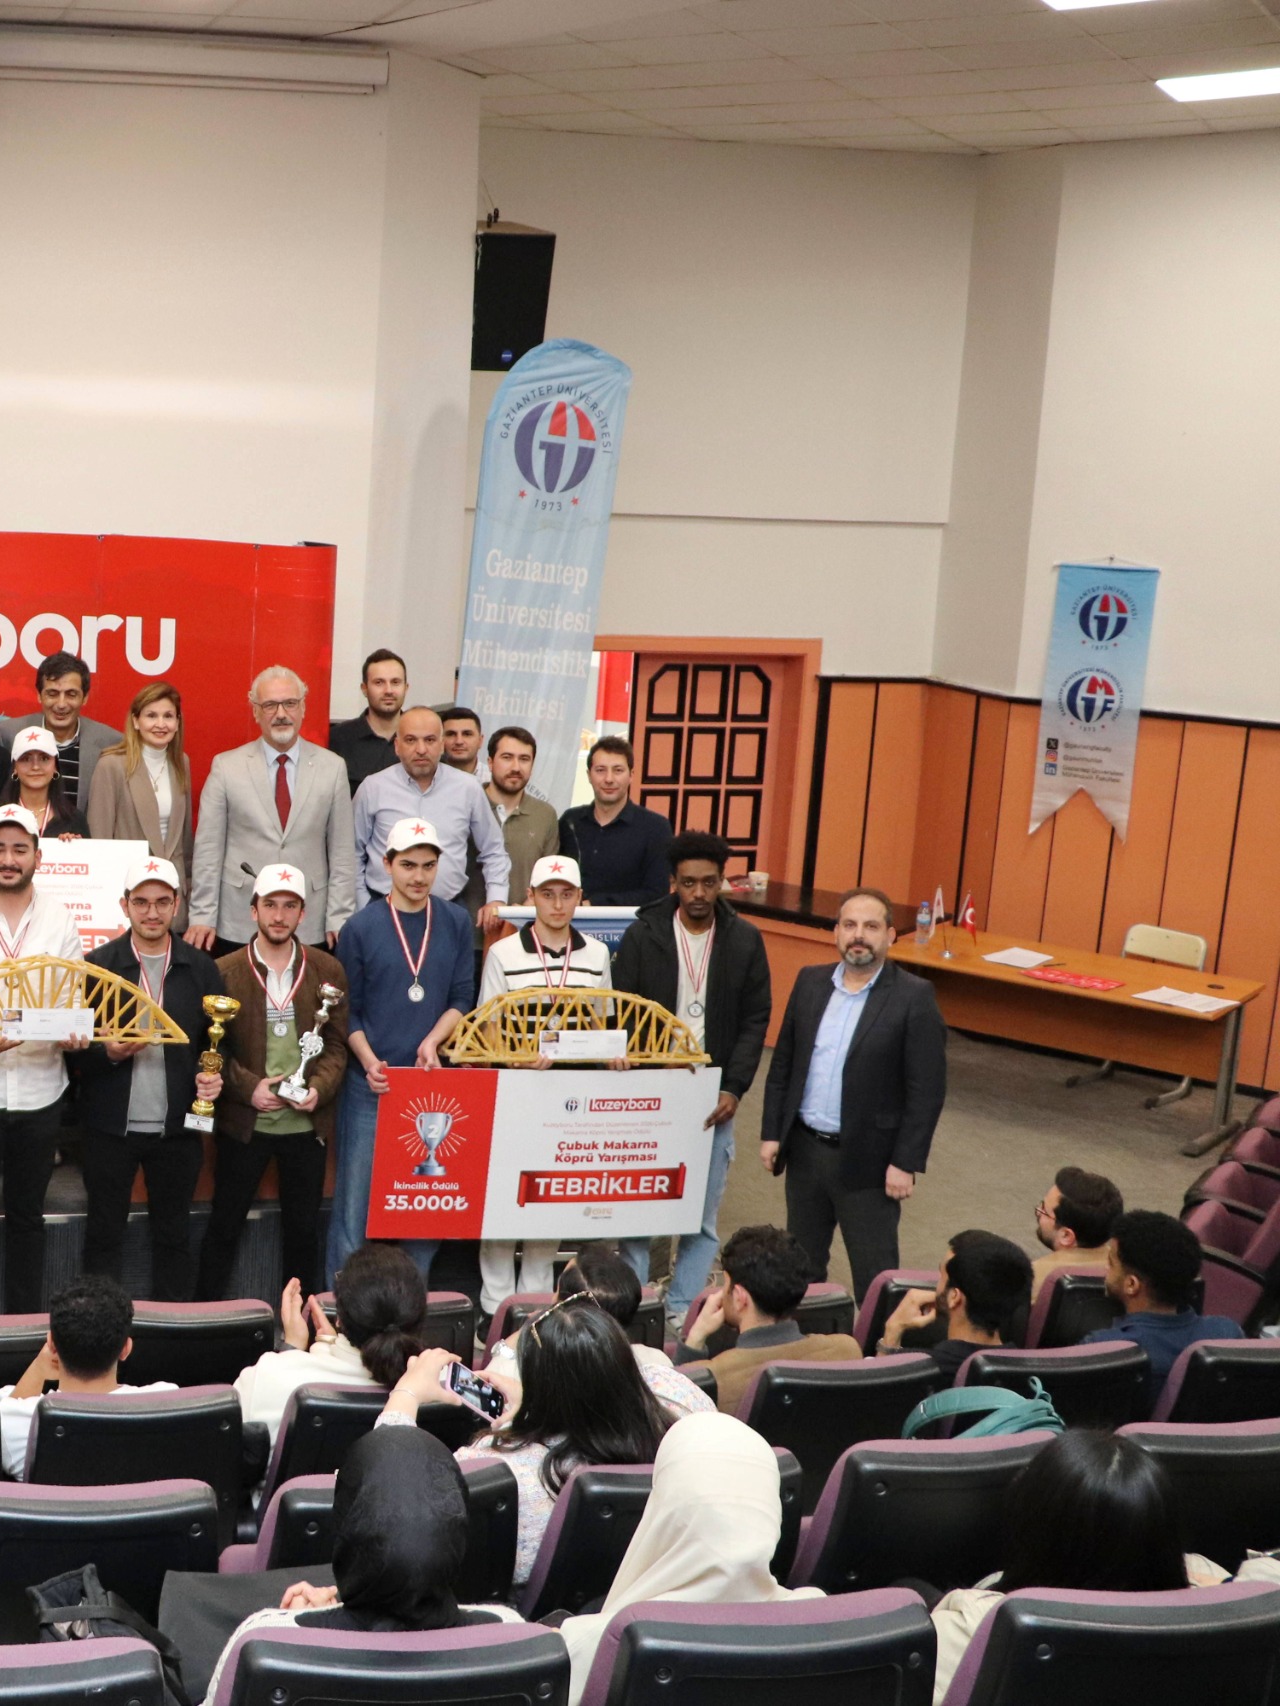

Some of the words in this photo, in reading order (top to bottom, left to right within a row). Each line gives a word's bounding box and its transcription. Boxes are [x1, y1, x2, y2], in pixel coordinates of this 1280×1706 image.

[534, 499, 562, 511] 1973
[486, 548, 589, 594] Gaziantep
[472, 585, 592, 634] Üniversitesi
[461, 638, 589, 678] Mühendislik
[472, 685, 567, 721] Fakültesi
[591, 1098, 659, 1111] kuzeyboru
[427, 1124, 440, 1138] 2
[557, 1141, 600, 1153] Çubuk
[603, 1140, 658, 1150] Makarna
[554, 1152, 594, 1165] Köprü
[598, 1152, 657, 1164] Yarışması
[393, 1180, 430, 1190] İkincilik
[431, 1180, 460, 1190] Ödülü
[535, 1171, 670, 1196] TEBRİKLER
